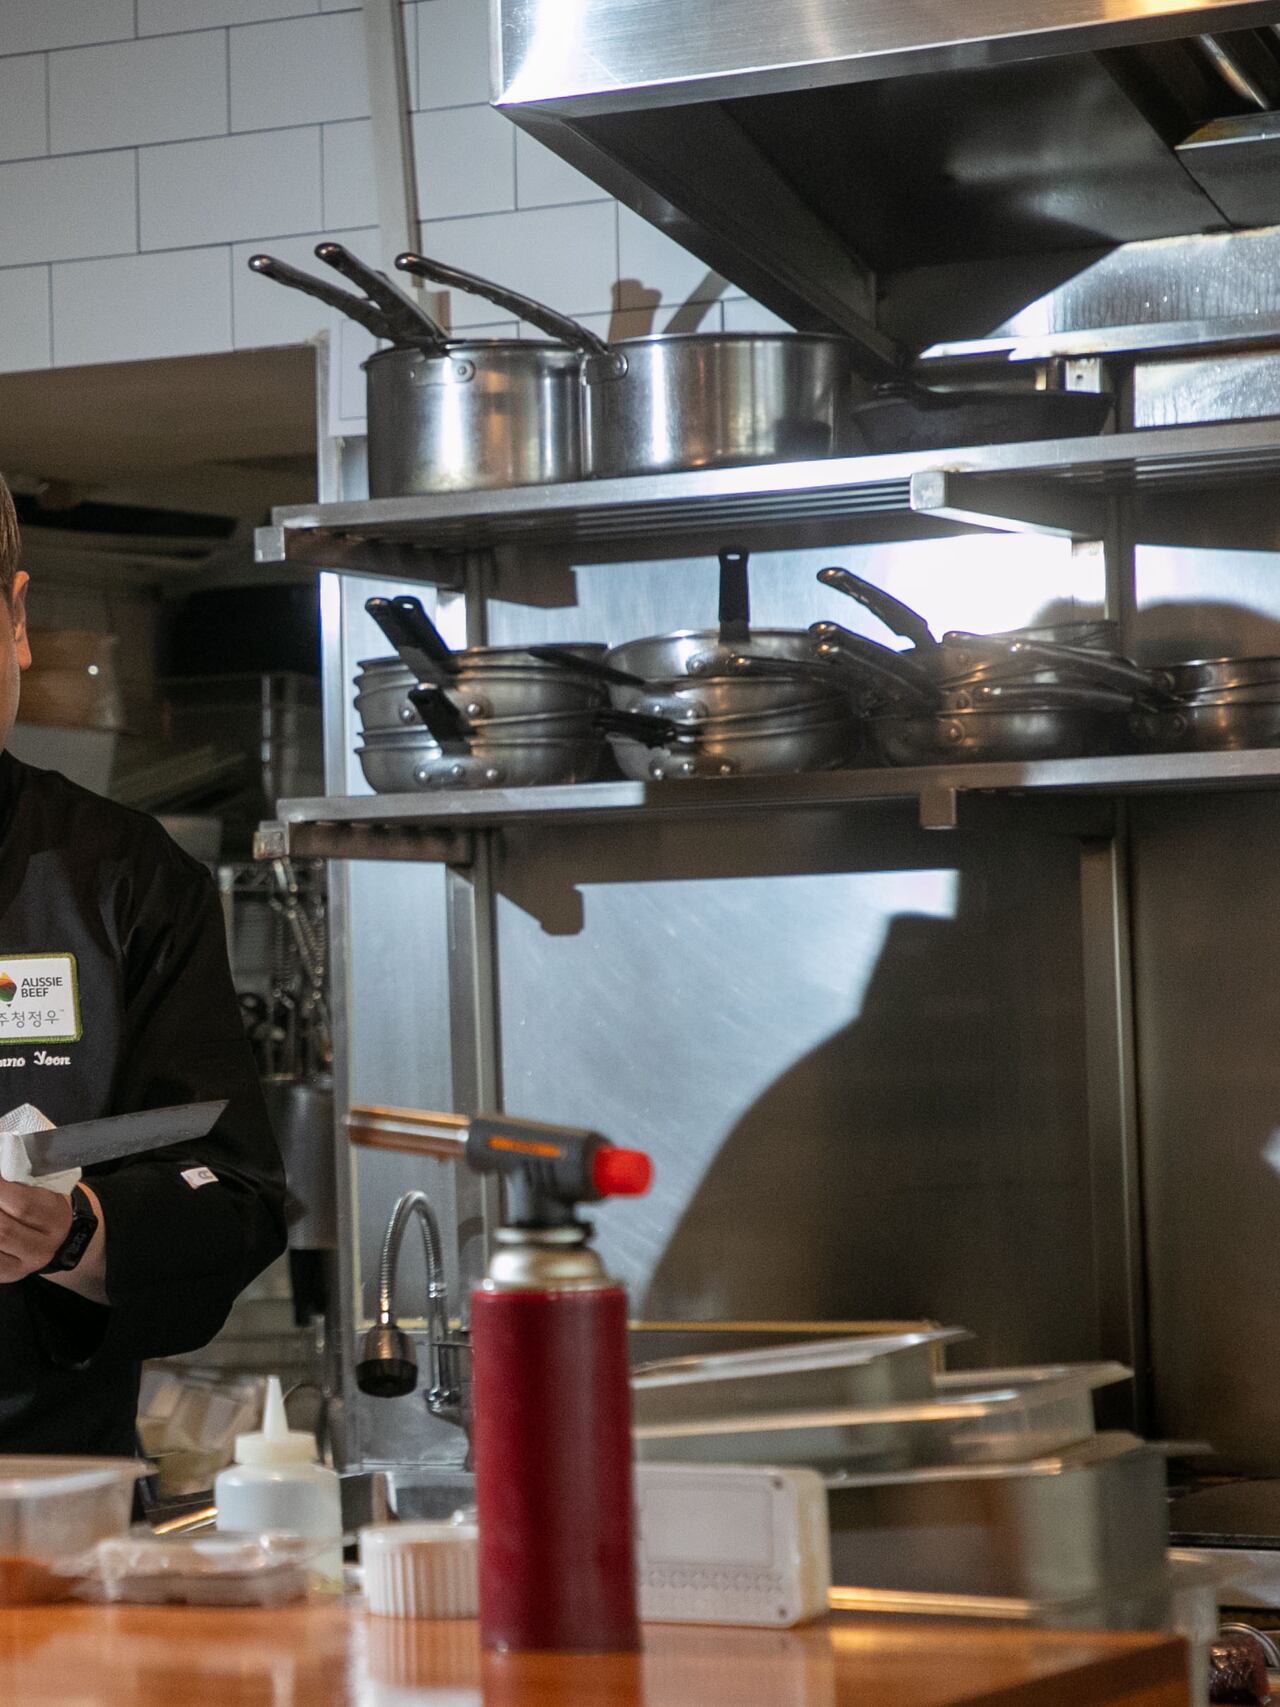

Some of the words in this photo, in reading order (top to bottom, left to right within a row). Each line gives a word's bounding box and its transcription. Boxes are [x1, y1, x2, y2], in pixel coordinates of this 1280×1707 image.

[21, 976, 64, 988] AUSSIE
[21, 988, 49, 998] BEEF
[33, 1050, 72, 1066] Yoon
